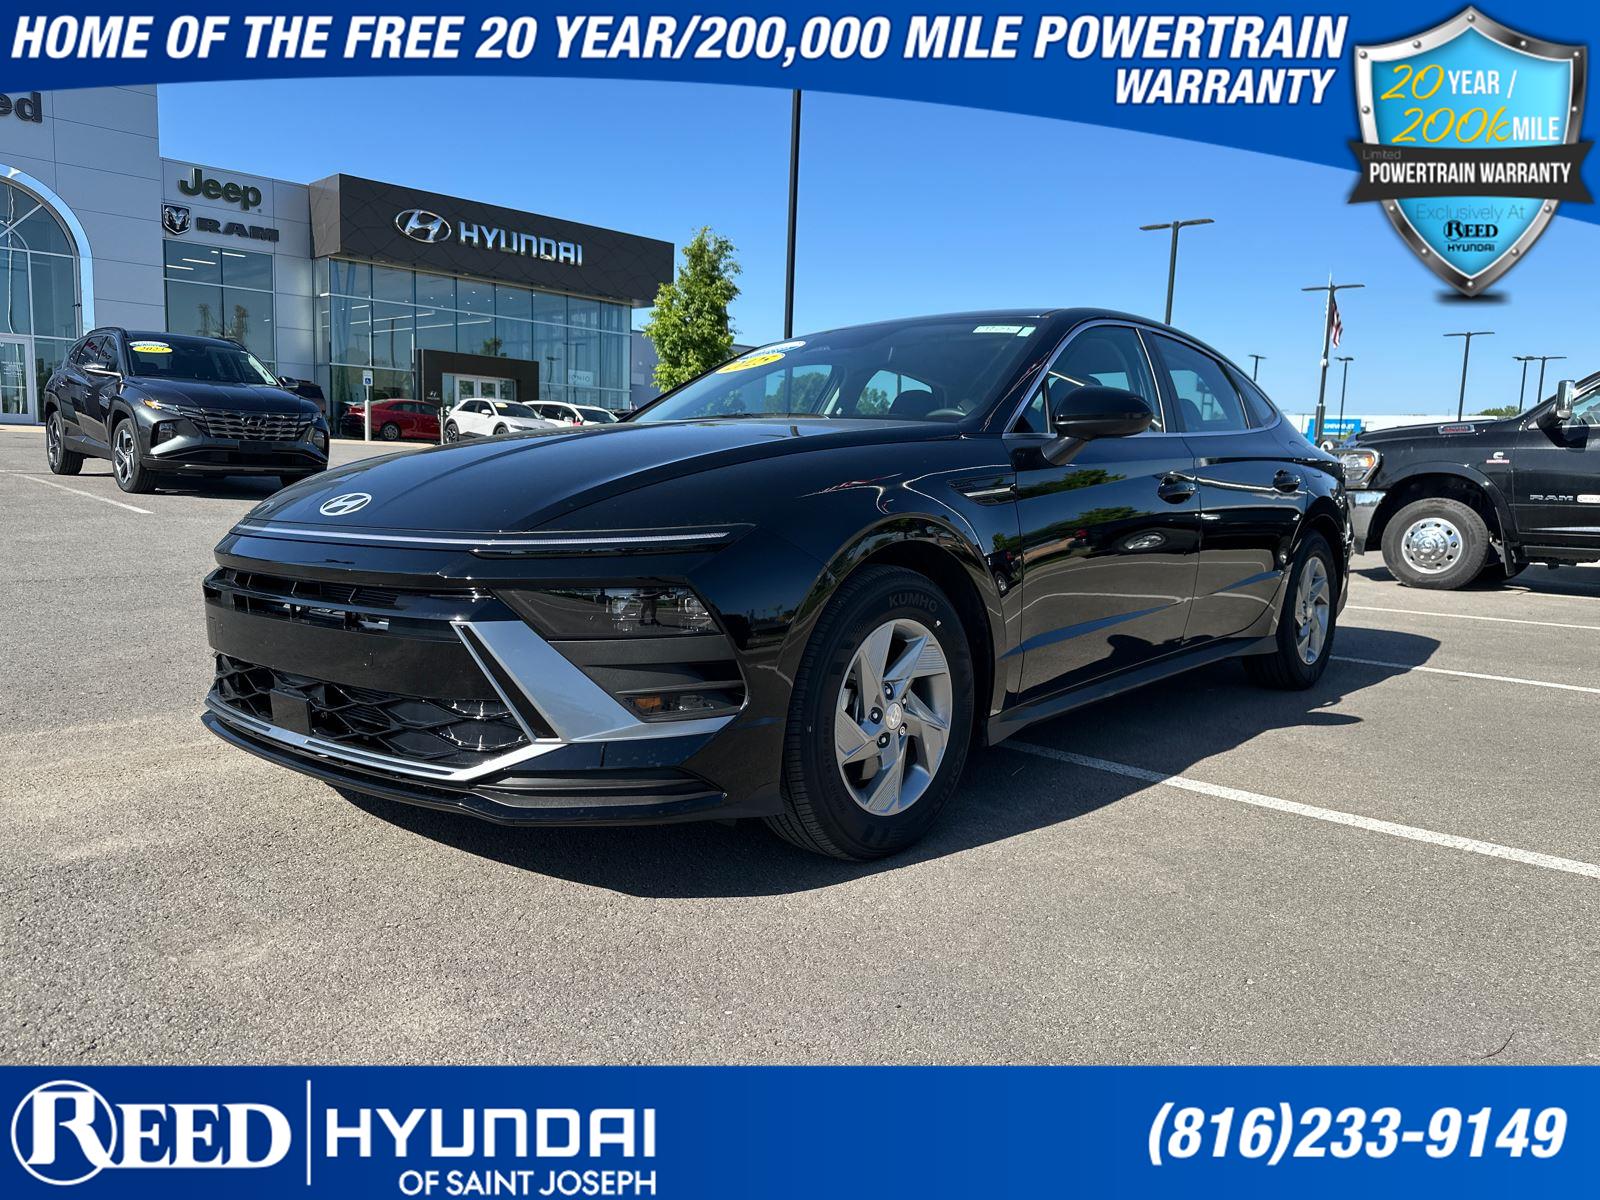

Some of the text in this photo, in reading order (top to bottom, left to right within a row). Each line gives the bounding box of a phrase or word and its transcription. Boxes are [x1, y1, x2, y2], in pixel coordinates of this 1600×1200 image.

[178, 168, 262, 211] Jeep
[196, 217, 280, 242] RAM
[458, 221, 583, 266] HYUNDAI
[889, 592, 938, 612] KUMHO
